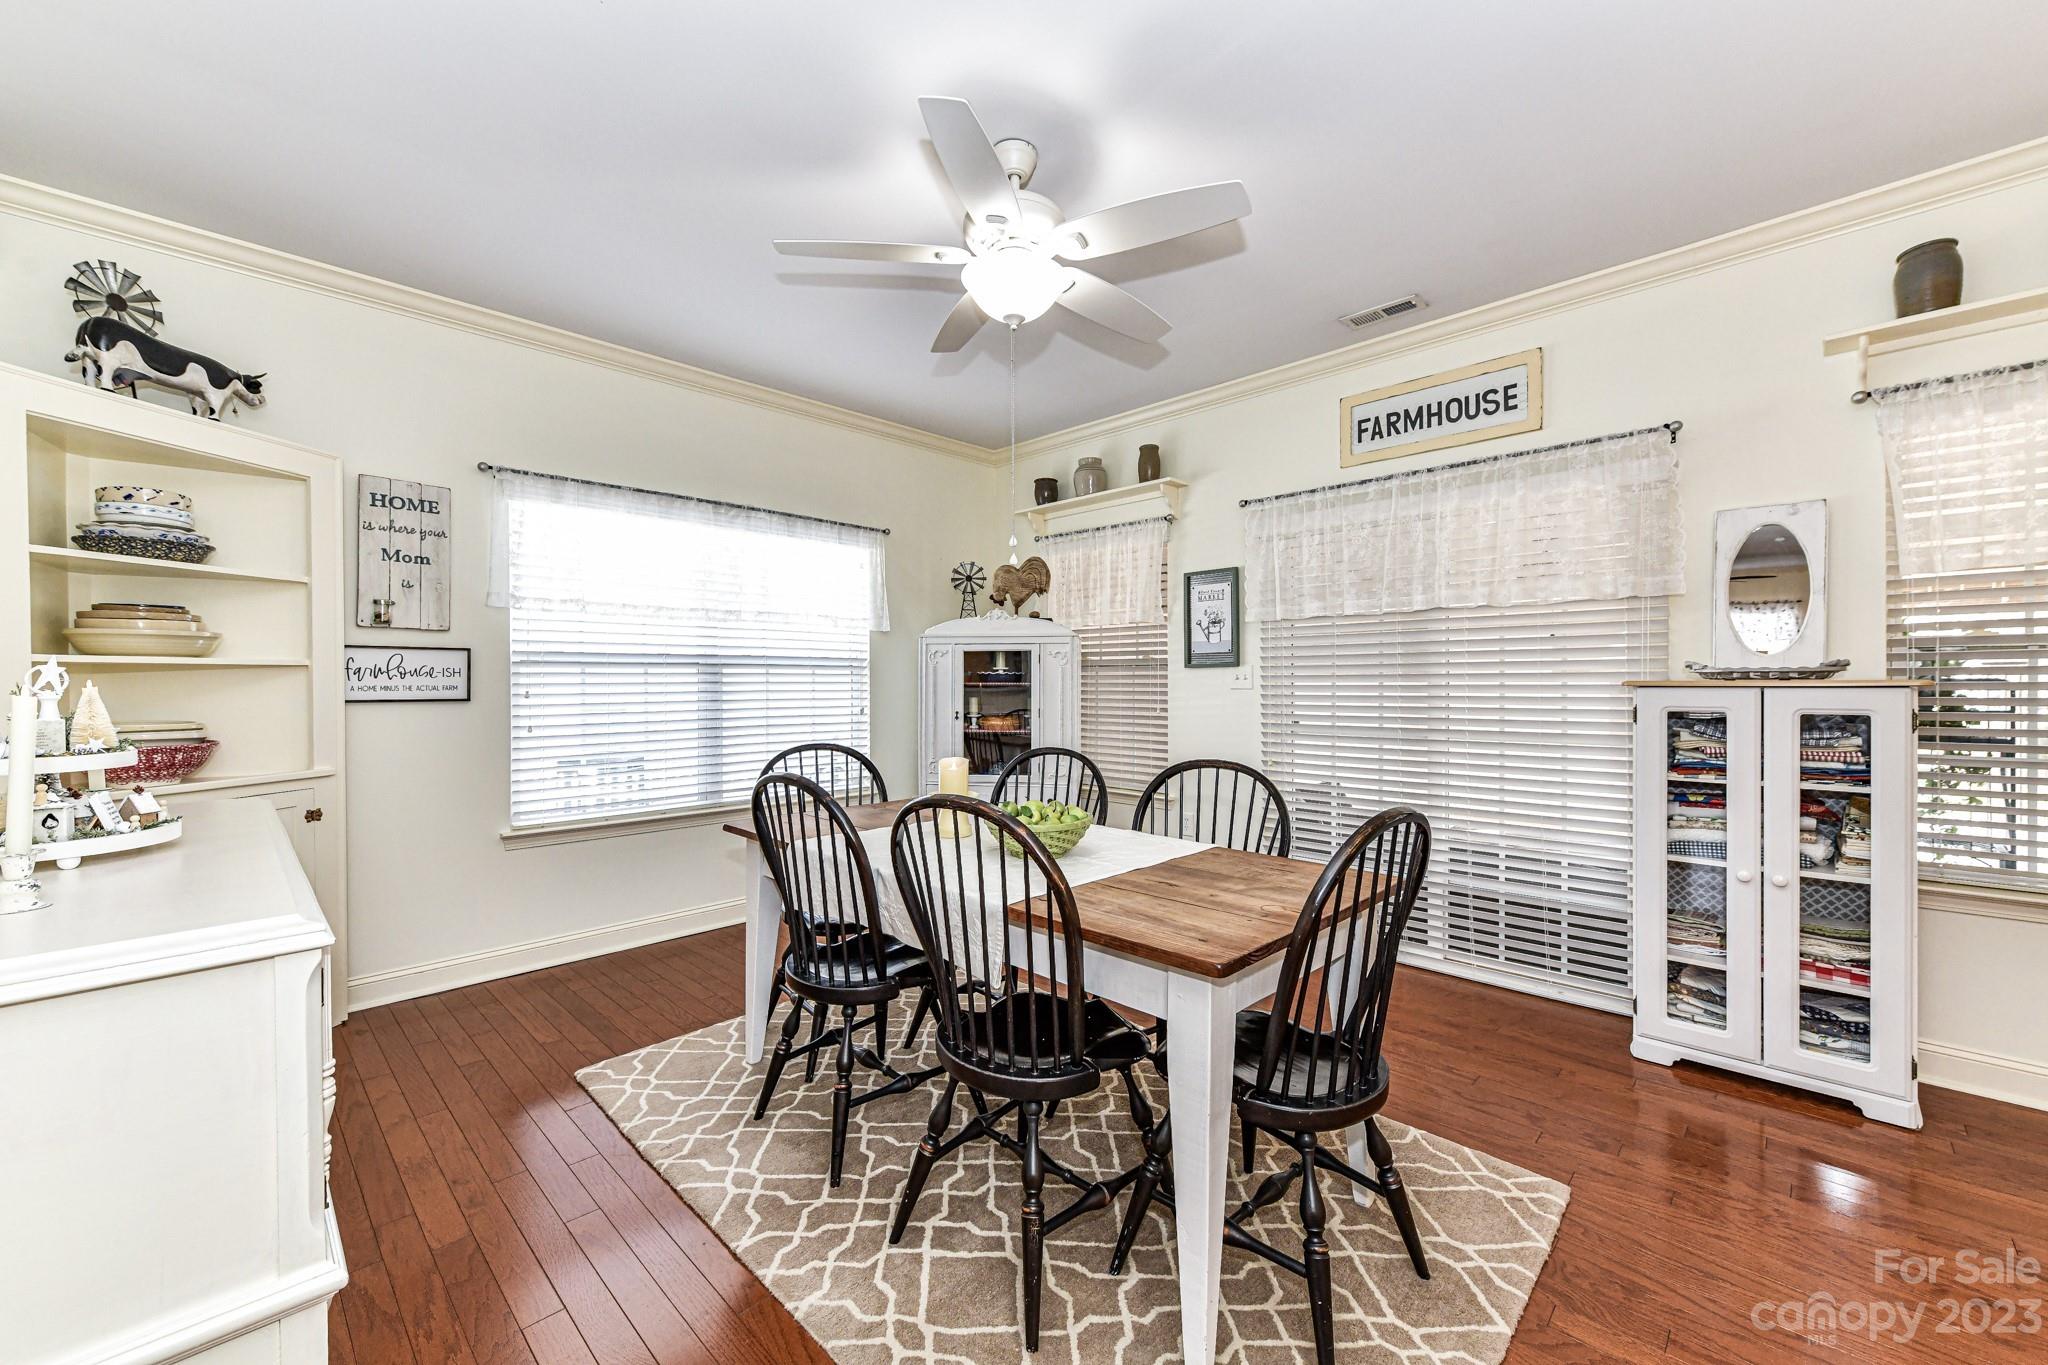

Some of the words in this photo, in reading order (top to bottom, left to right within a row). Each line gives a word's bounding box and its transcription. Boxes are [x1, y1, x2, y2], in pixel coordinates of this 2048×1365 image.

[1357, 382, 1519, 444] FARMHOUSE
[369, 492, 440, 514] HOME
[362, 520, 376, 530] is
[378, 519, 417, 535] where
[419, 528, 448, 541] your
[381, 547, 432, 566] Mom
[401, 579, 414, 589] is
